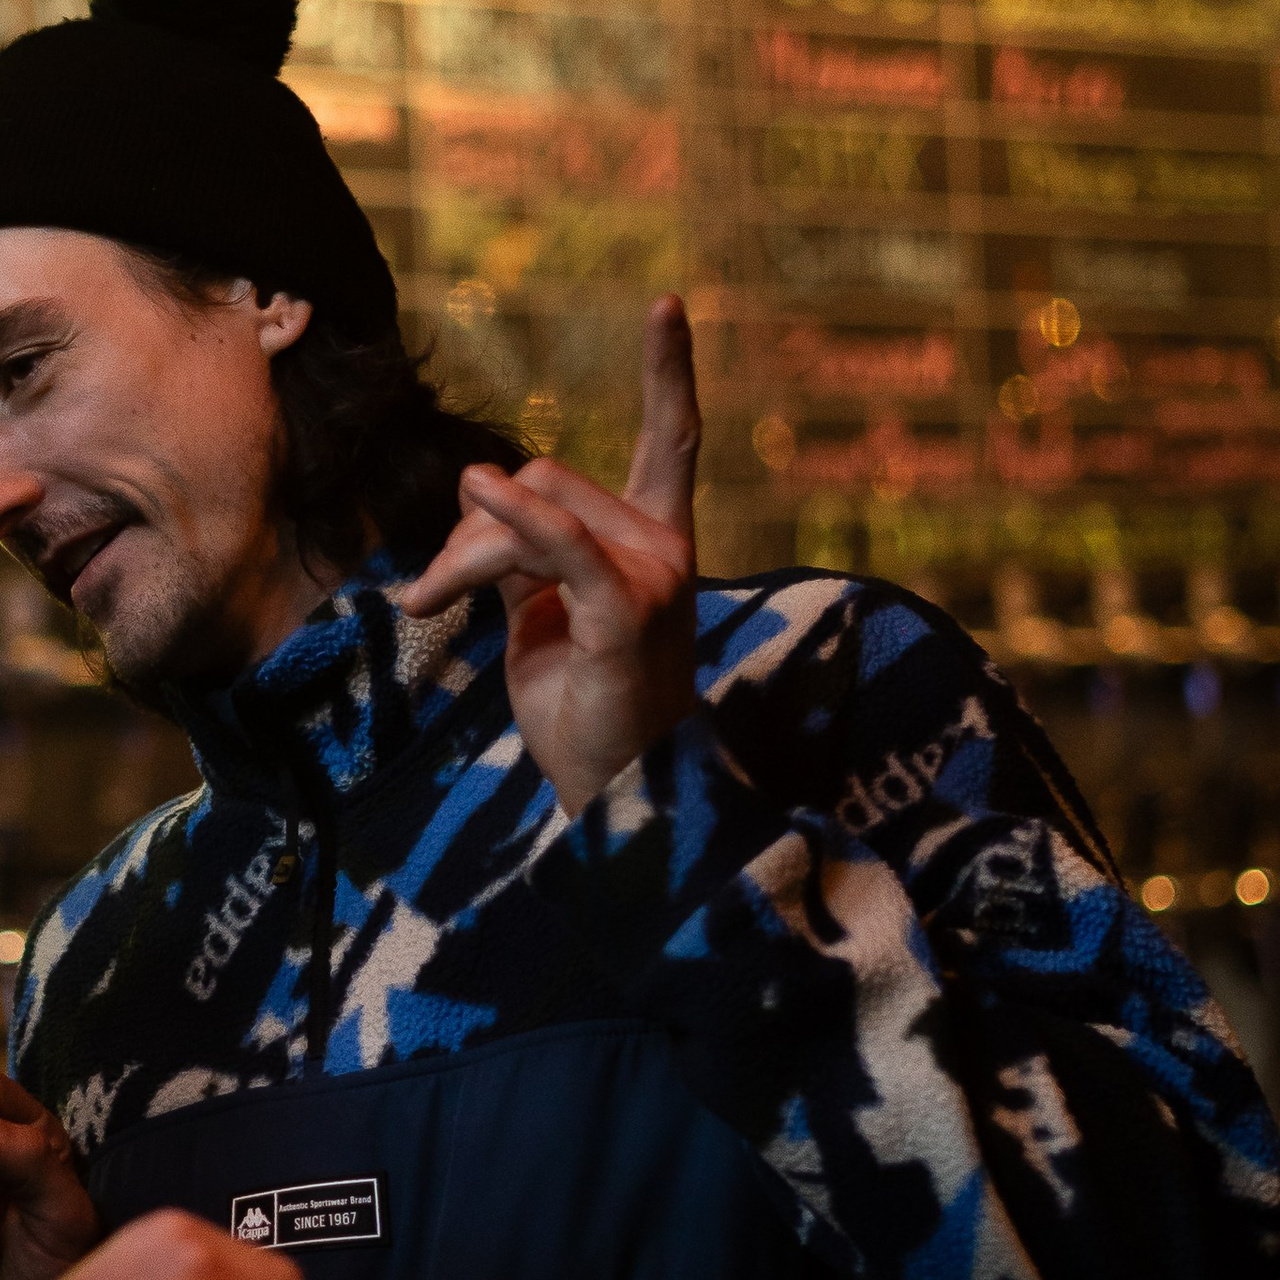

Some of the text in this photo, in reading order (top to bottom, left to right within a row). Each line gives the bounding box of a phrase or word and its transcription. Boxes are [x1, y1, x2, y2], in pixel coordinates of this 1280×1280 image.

[279, 1195, 372, 1213] Authentic Sportswear Brand
[294, 1211, 357, 1231] SINCE 1967
[237, 1226, 270, 1241] Kappa
